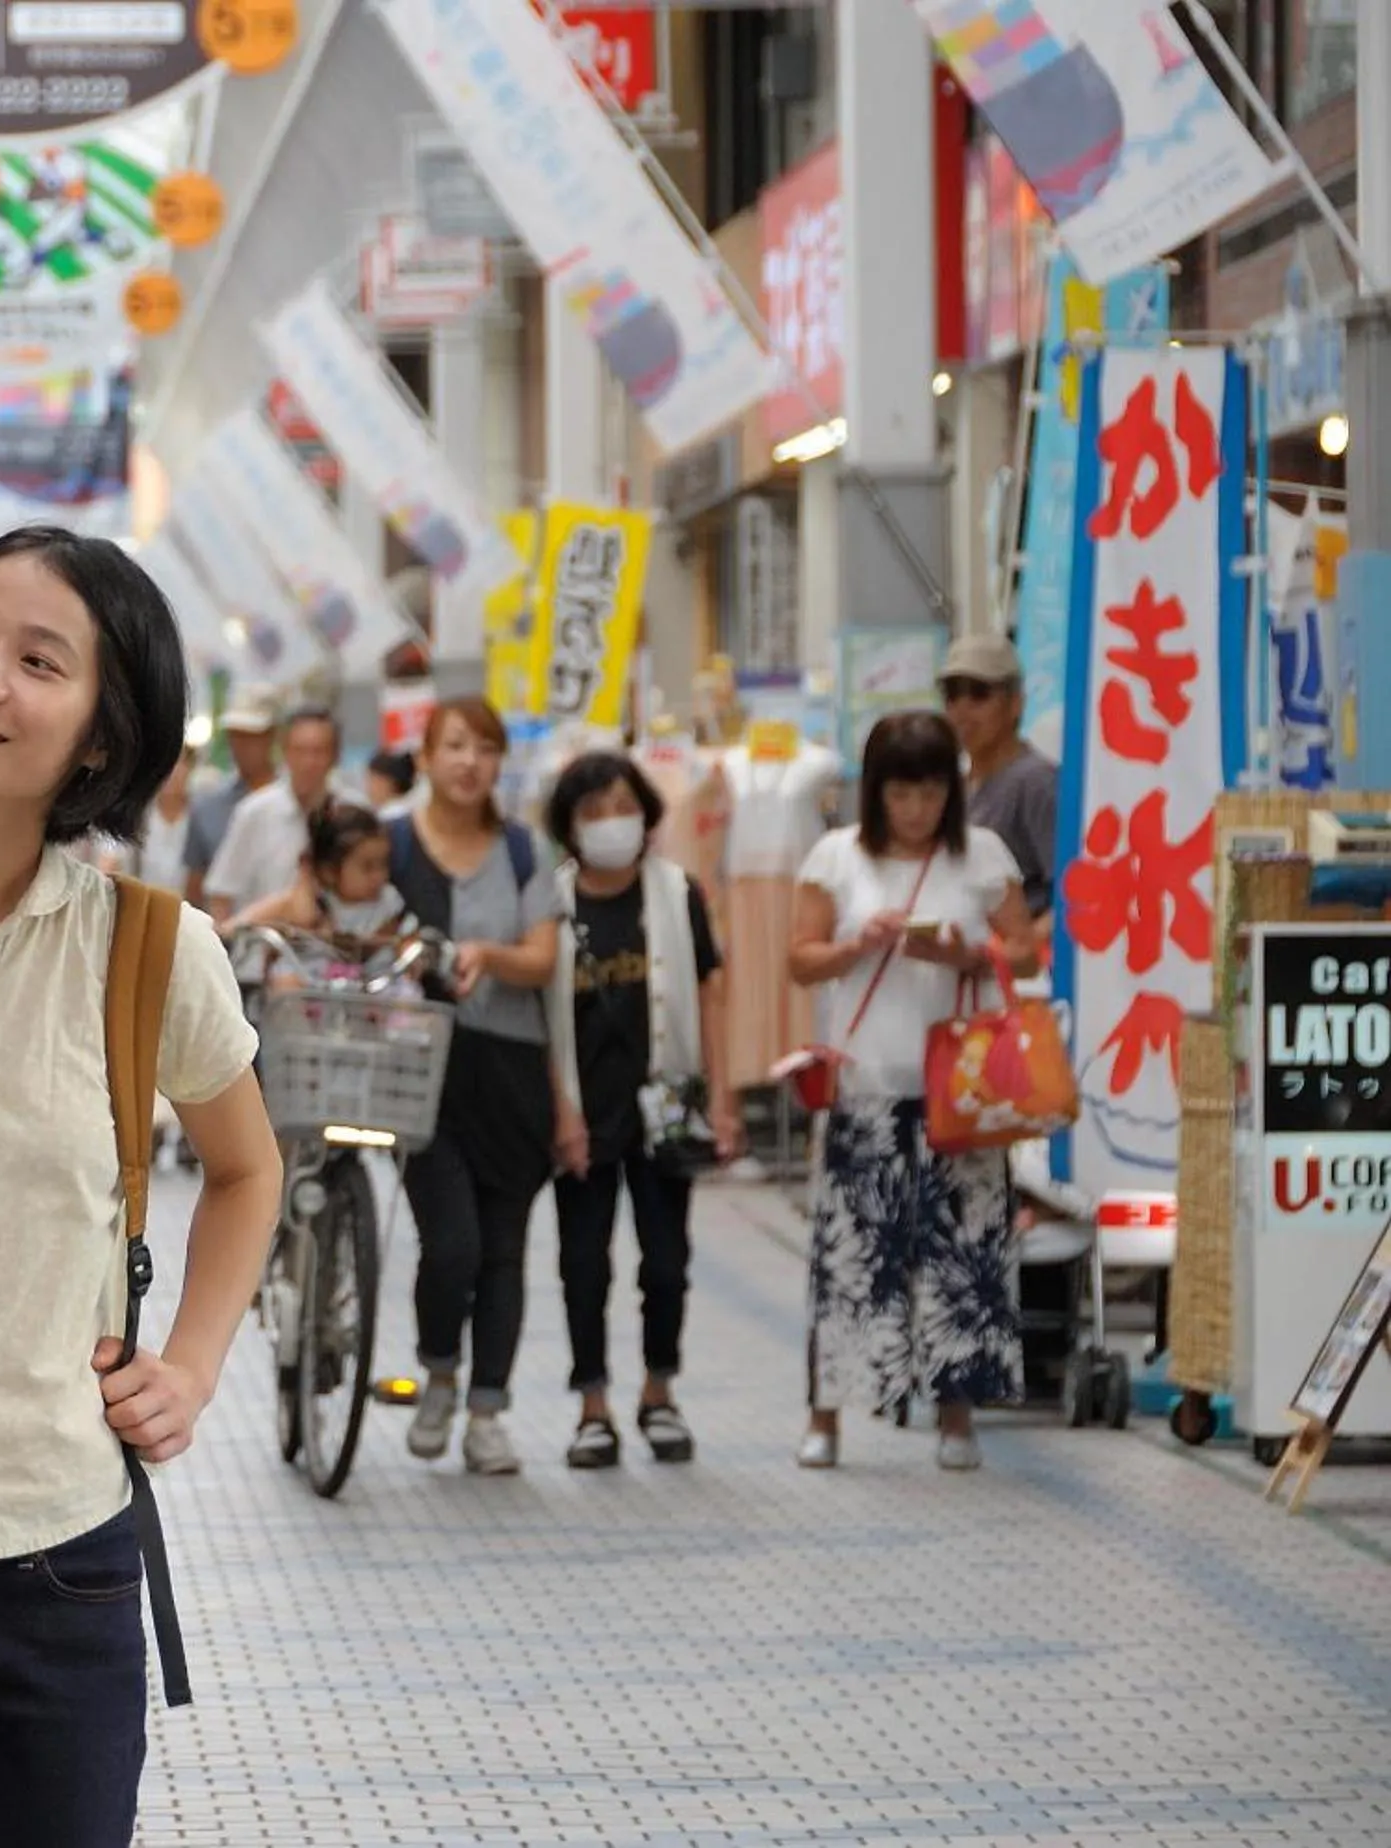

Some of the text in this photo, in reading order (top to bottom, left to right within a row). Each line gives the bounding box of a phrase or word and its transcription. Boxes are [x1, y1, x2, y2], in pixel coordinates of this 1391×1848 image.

[1062, 368, 1226, 976] かき氷
[1311, 954, 1391, 995] Caf
[1268, 1003, 1391, 1068] LATO
